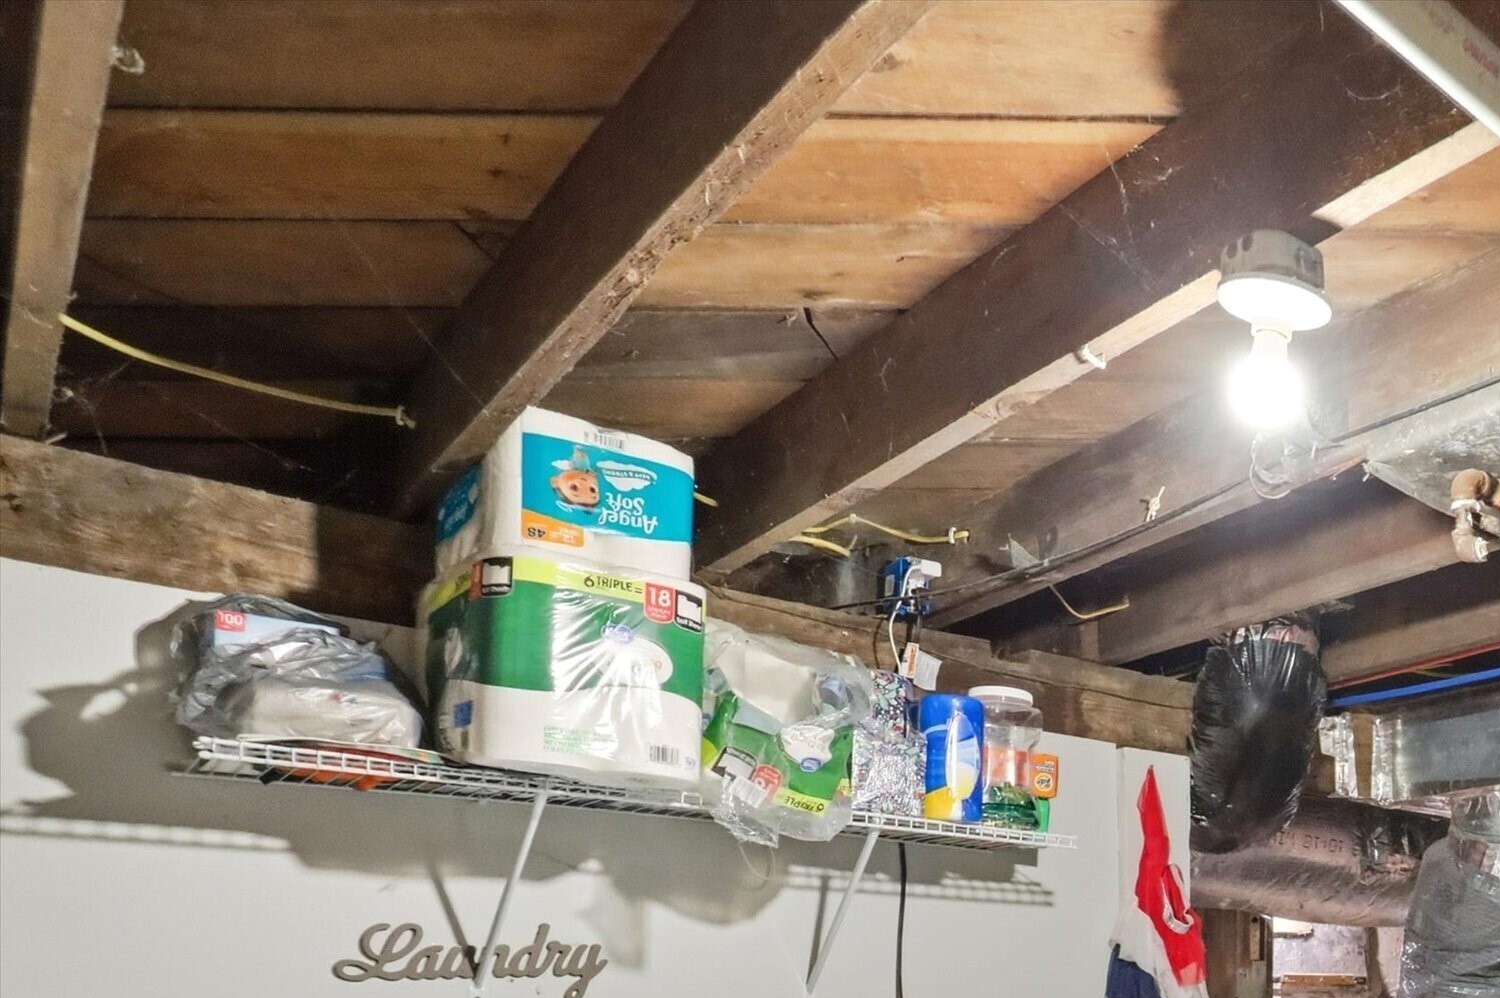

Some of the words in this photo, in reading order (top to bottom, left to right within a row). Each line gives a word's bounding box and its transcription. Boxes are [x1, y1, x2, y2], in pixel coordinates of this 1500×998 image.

[606, 492, 645, 516] Soft
[599, 508, 658, 534] Angel
[584, 575, 595, 588] 6
[596, 576, 632, 592] TRIPLE
[651, 587, 672, 607] 18
